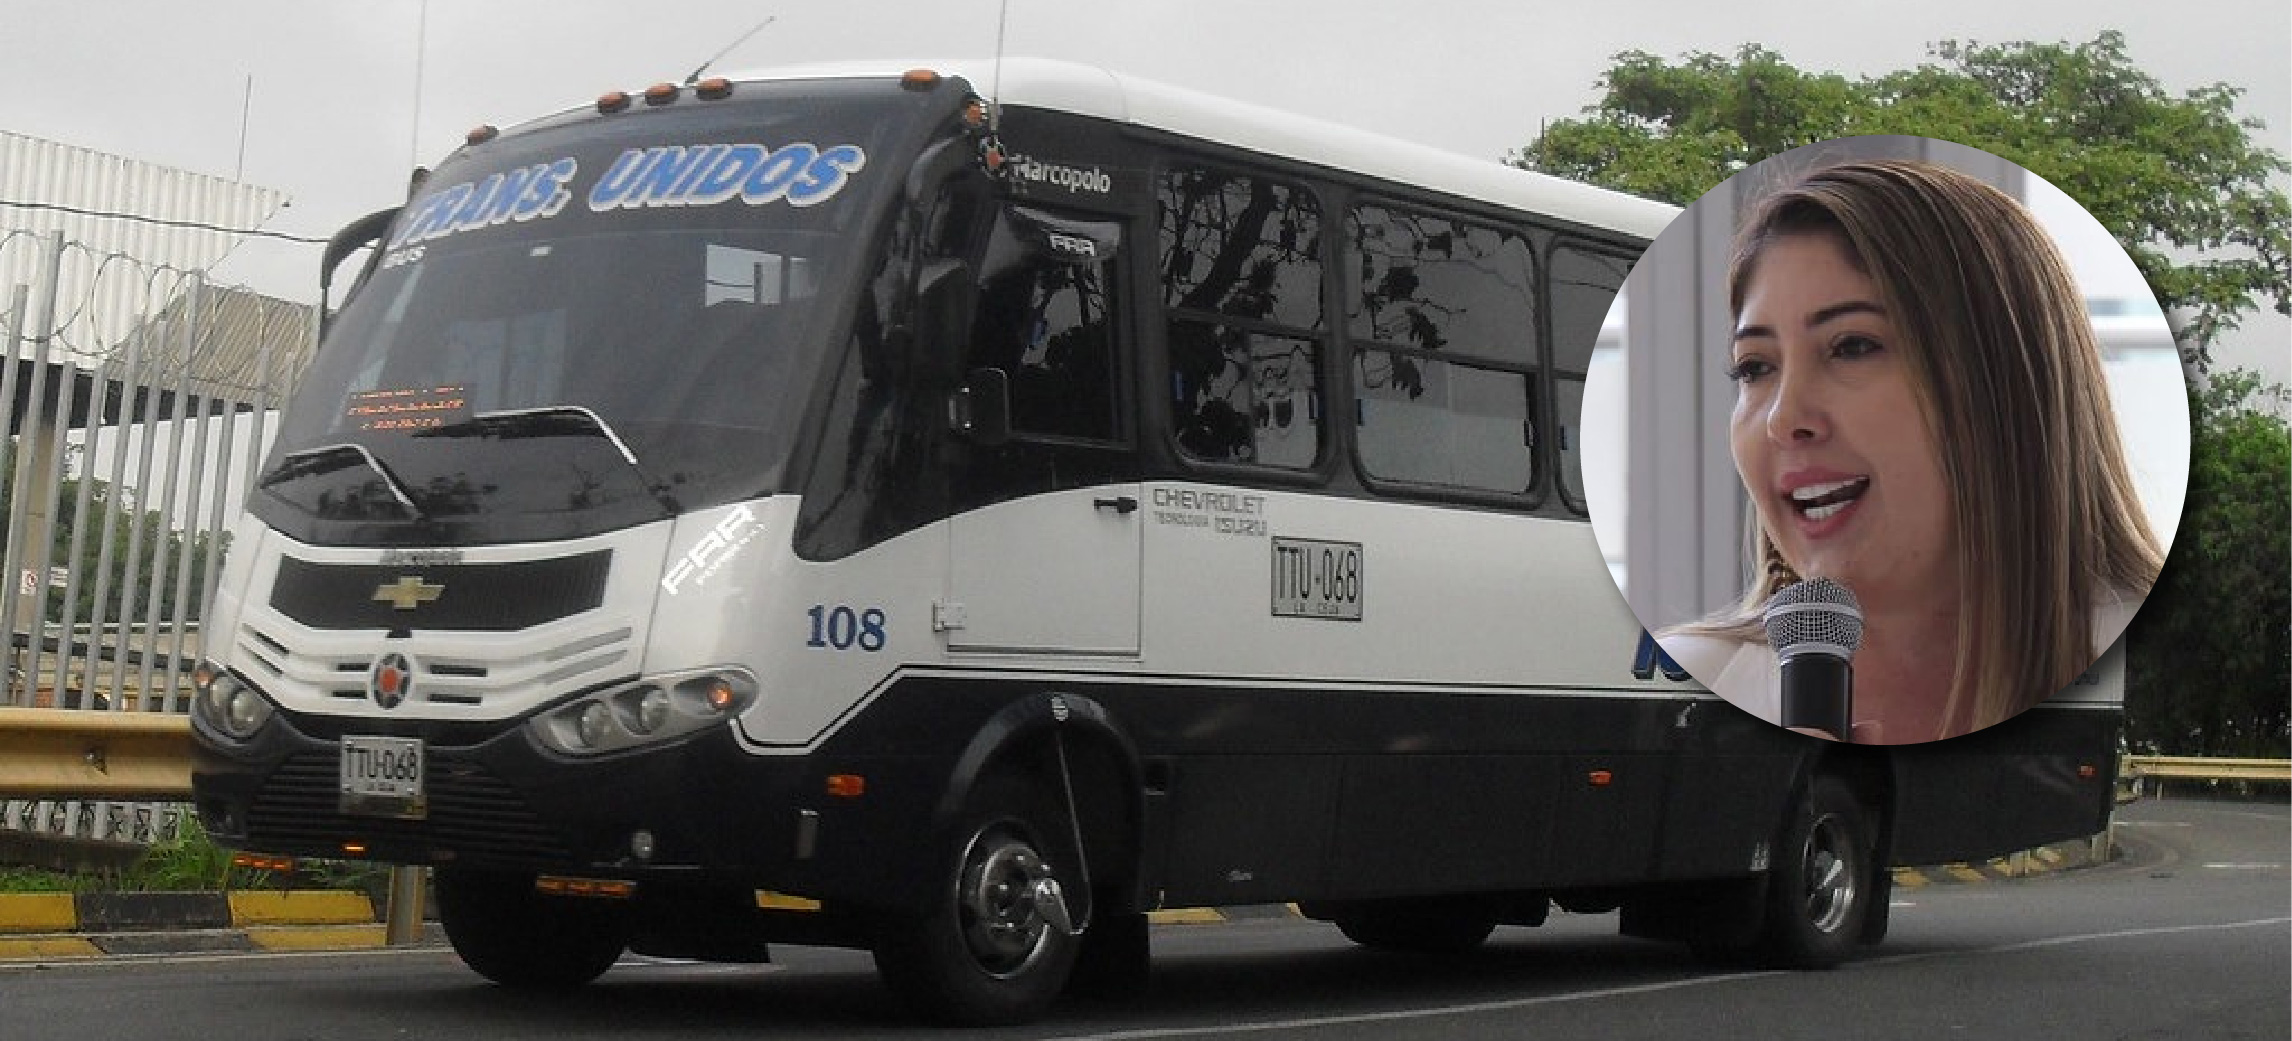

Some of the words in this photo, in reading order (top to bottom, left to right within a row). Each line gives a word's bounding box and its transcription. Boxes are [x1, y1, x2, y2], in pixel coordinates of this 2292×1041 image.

[589, 143, 866, 211] UNIDOS
[1153, 488, 1267, 515] CHEVROLET
[806, 604, 887, 653] 108
